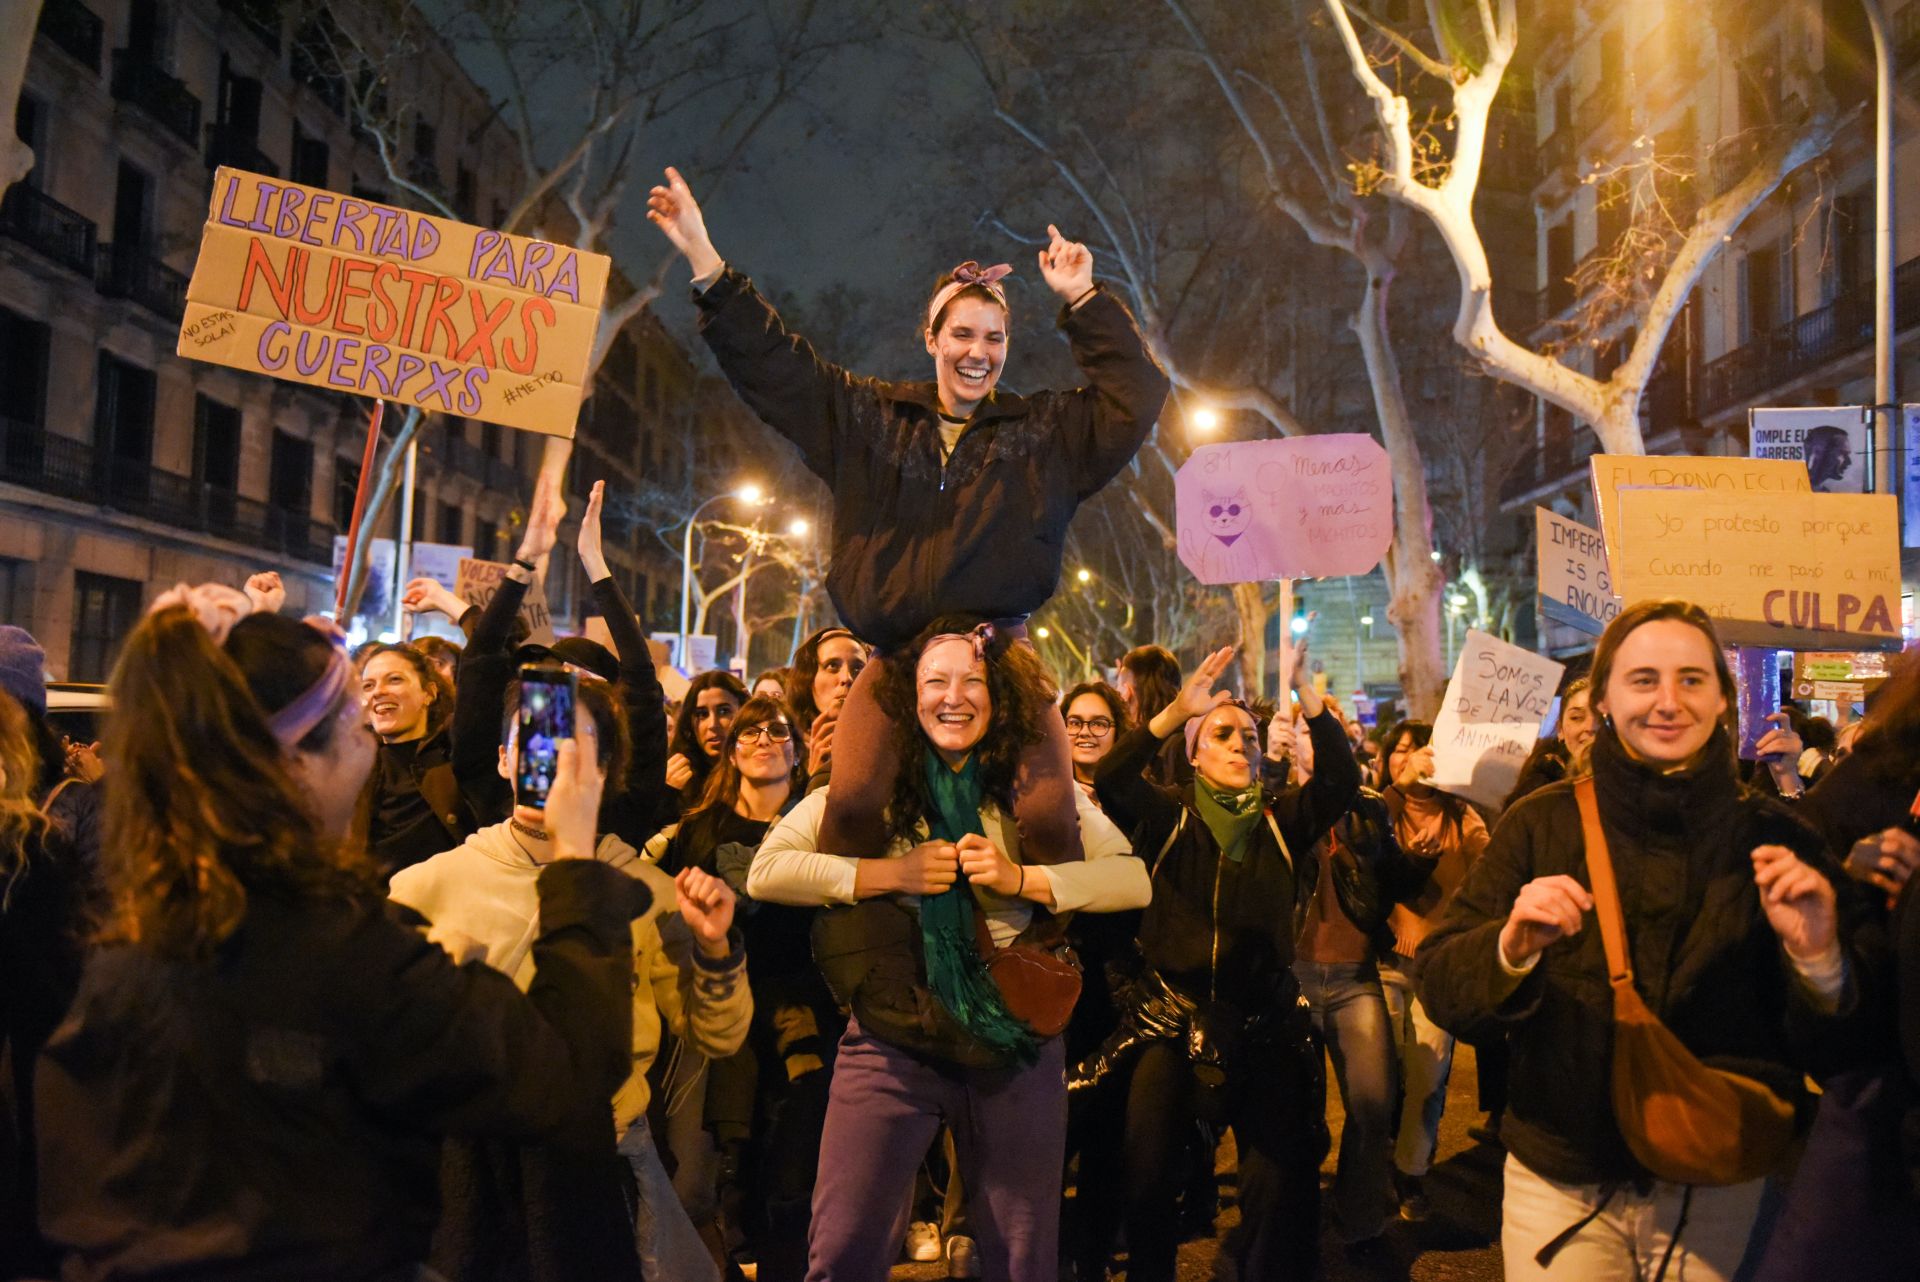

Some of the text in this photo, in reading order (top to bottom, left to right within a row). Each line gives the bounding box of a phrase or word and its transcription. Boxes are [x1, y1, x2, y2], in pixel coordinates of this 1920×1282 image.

[218, 177, 580, 302] LIBERTAD PARA
[238, 237, 556, 375] NUESTRXS
[183, 311, 234, 340] NO ESTAS
[257, 320, 489, 416] CUERPXS
[1755, 429, 1792, 444] OMPLE
[1755, 446, 1803, 460] CARRERS
[1655, 512, 1873, 545] Yo protesto porque
[1566, 558, 1587, 580] IS
[1649, 557, 1722, 577] Cuando
[1749, 562, 1774, 578] me
[1788, 560, 1824, 583] pasó
[1844, 568, 1855, 580] a
[1762, 589, 1894, 633] CULPA
[1477, 651, 1544, 690] SOMOS
[1453, 697, 1482, 717] DE
[1486, 683, 1509, 708] LA
